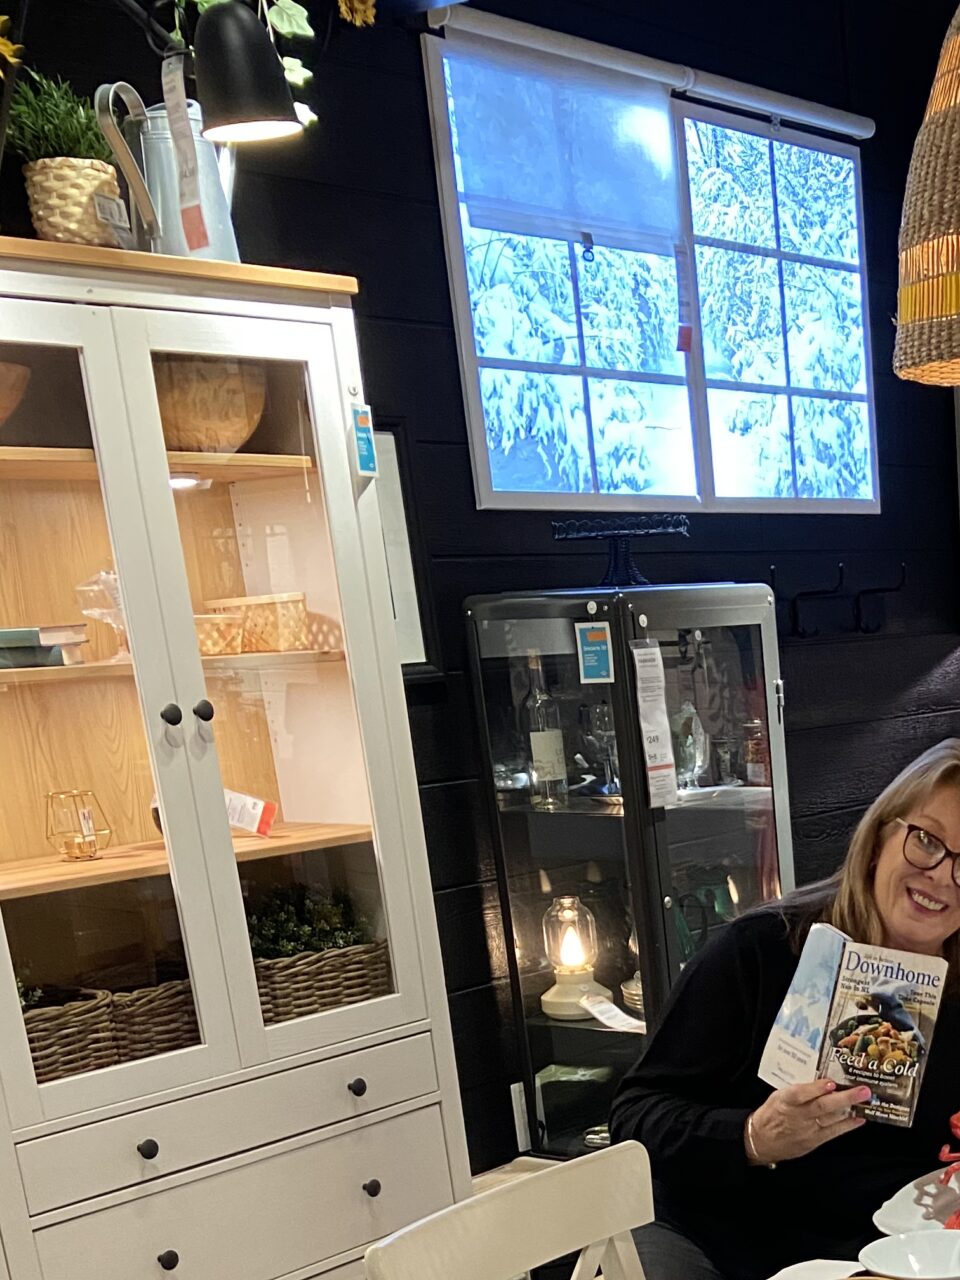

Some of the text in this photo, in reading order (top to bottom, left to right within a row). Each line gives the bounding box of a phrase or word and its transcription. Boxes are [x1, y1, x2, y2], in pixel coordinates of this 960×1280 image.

[845, 950, 941, 988] Downhome
[829, 1047, 866, 1068] Feed
[868, 1059, 878, 1070] a
[884, 1058, 919, 1076] Cold
